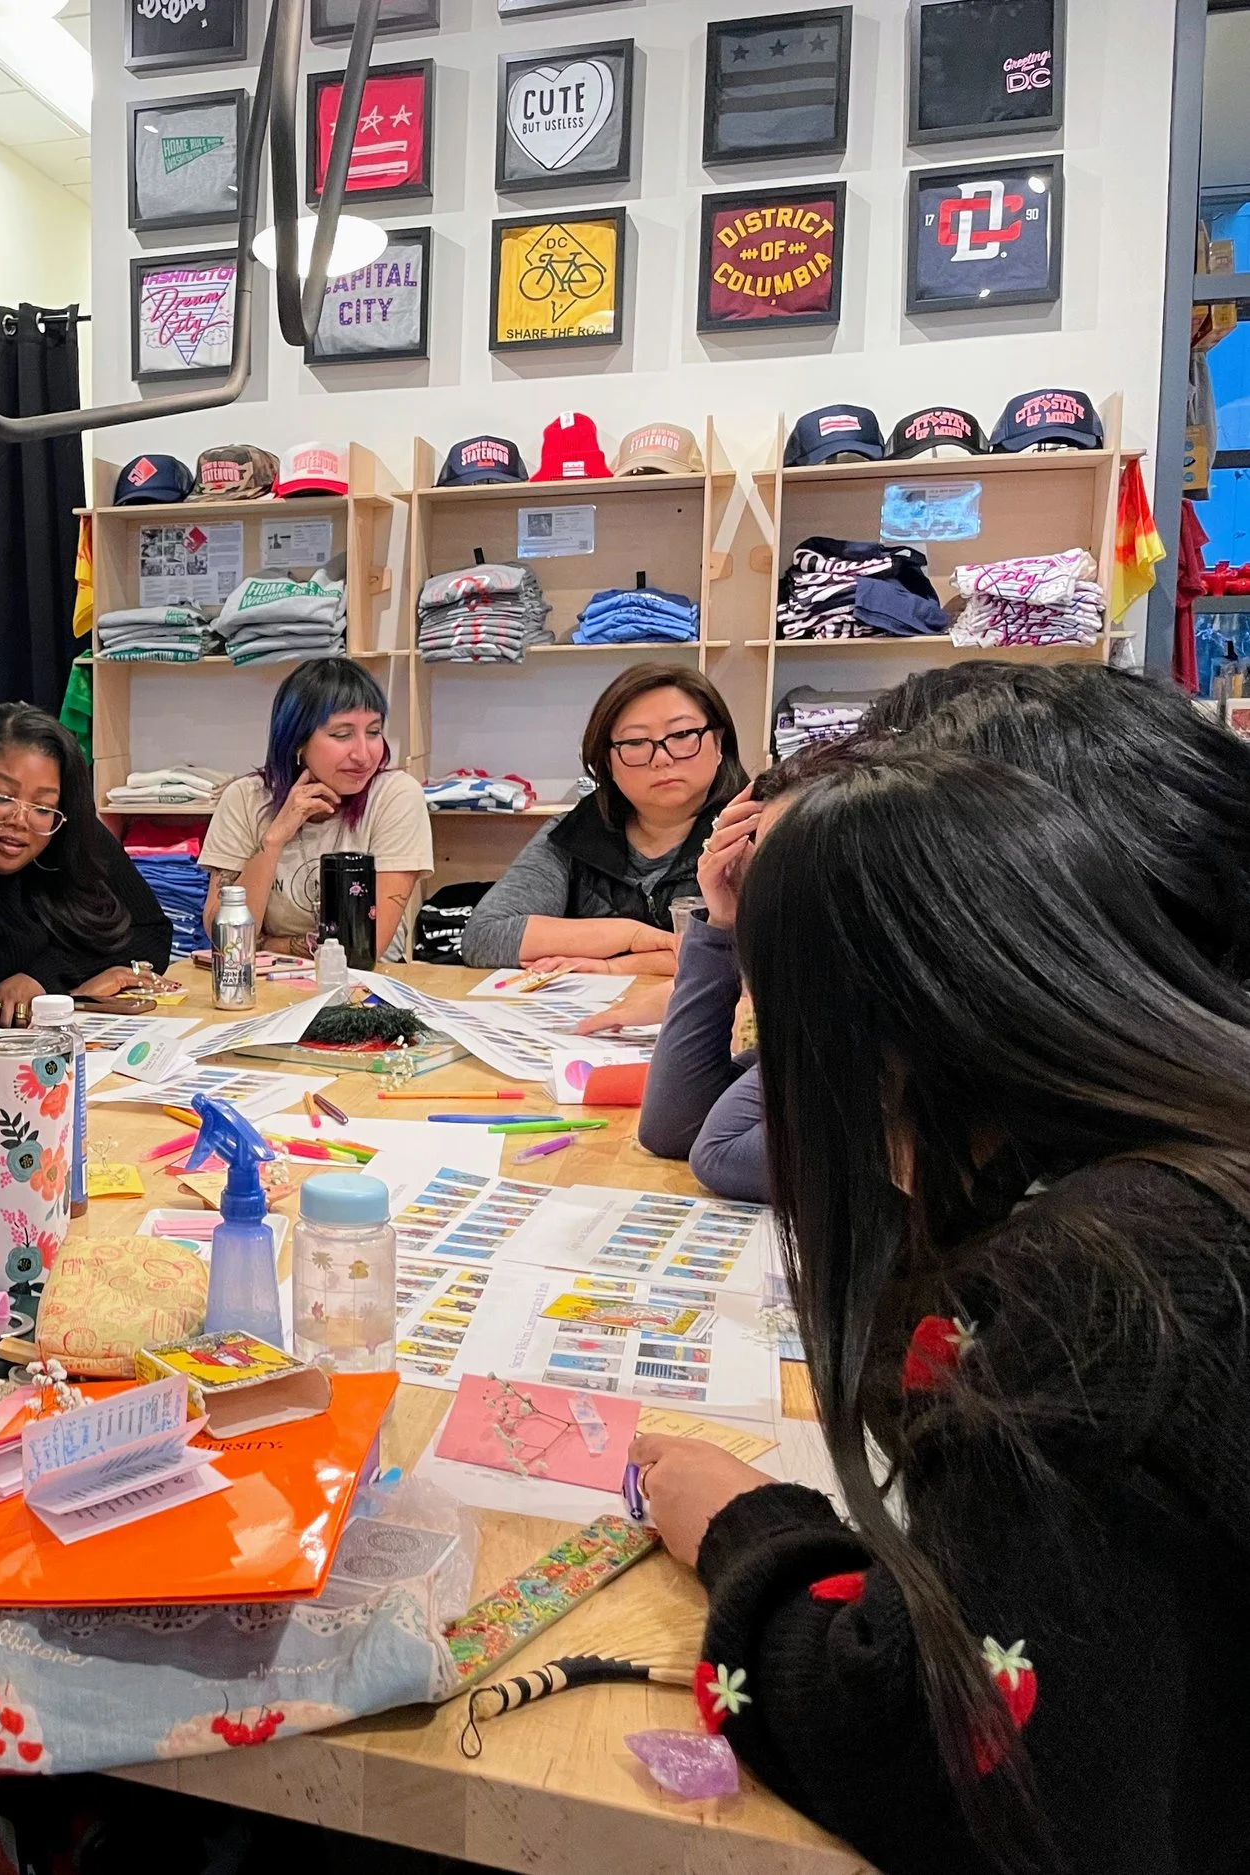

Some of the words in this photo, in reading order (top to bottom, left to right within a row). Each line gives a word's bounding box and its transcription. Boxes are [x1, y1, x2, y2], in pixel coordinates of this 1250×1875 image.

[523, 82, 585, 120] CUTE
[522, 121, 540, 134] BUT
[545, 117, 584, 131] USELESS
[163, 138, 189, 157] HOME
[925, 214, 935, 226] 17
[1025, 208, 1039, 221] 90
[717, 207, 834, 248] DISTRICT
[546, 236, 568, 249] DC
[760, 240, 786, 261] OF
[713, 252, 832, 297] COLUMBIA
[142, 286, 226, 322] Dream
[339, 298, 393, 326] CITY
[159, 311, 229, 344] City
[506, 327, 547, 339] SHARE
[550, 326, 574, 337] THE
[577, 325, 612, 336] ROA
[1015, 401, 1041, 424] CITY
[1051, 398, 1085, 420] STATE
[905, 420, 932, 439] CITY
[629, 434, 680, 454] STATEHOOD
[461, 447, 509, 466] STATEHOOD
[247, 582, 288, 597] HOME
